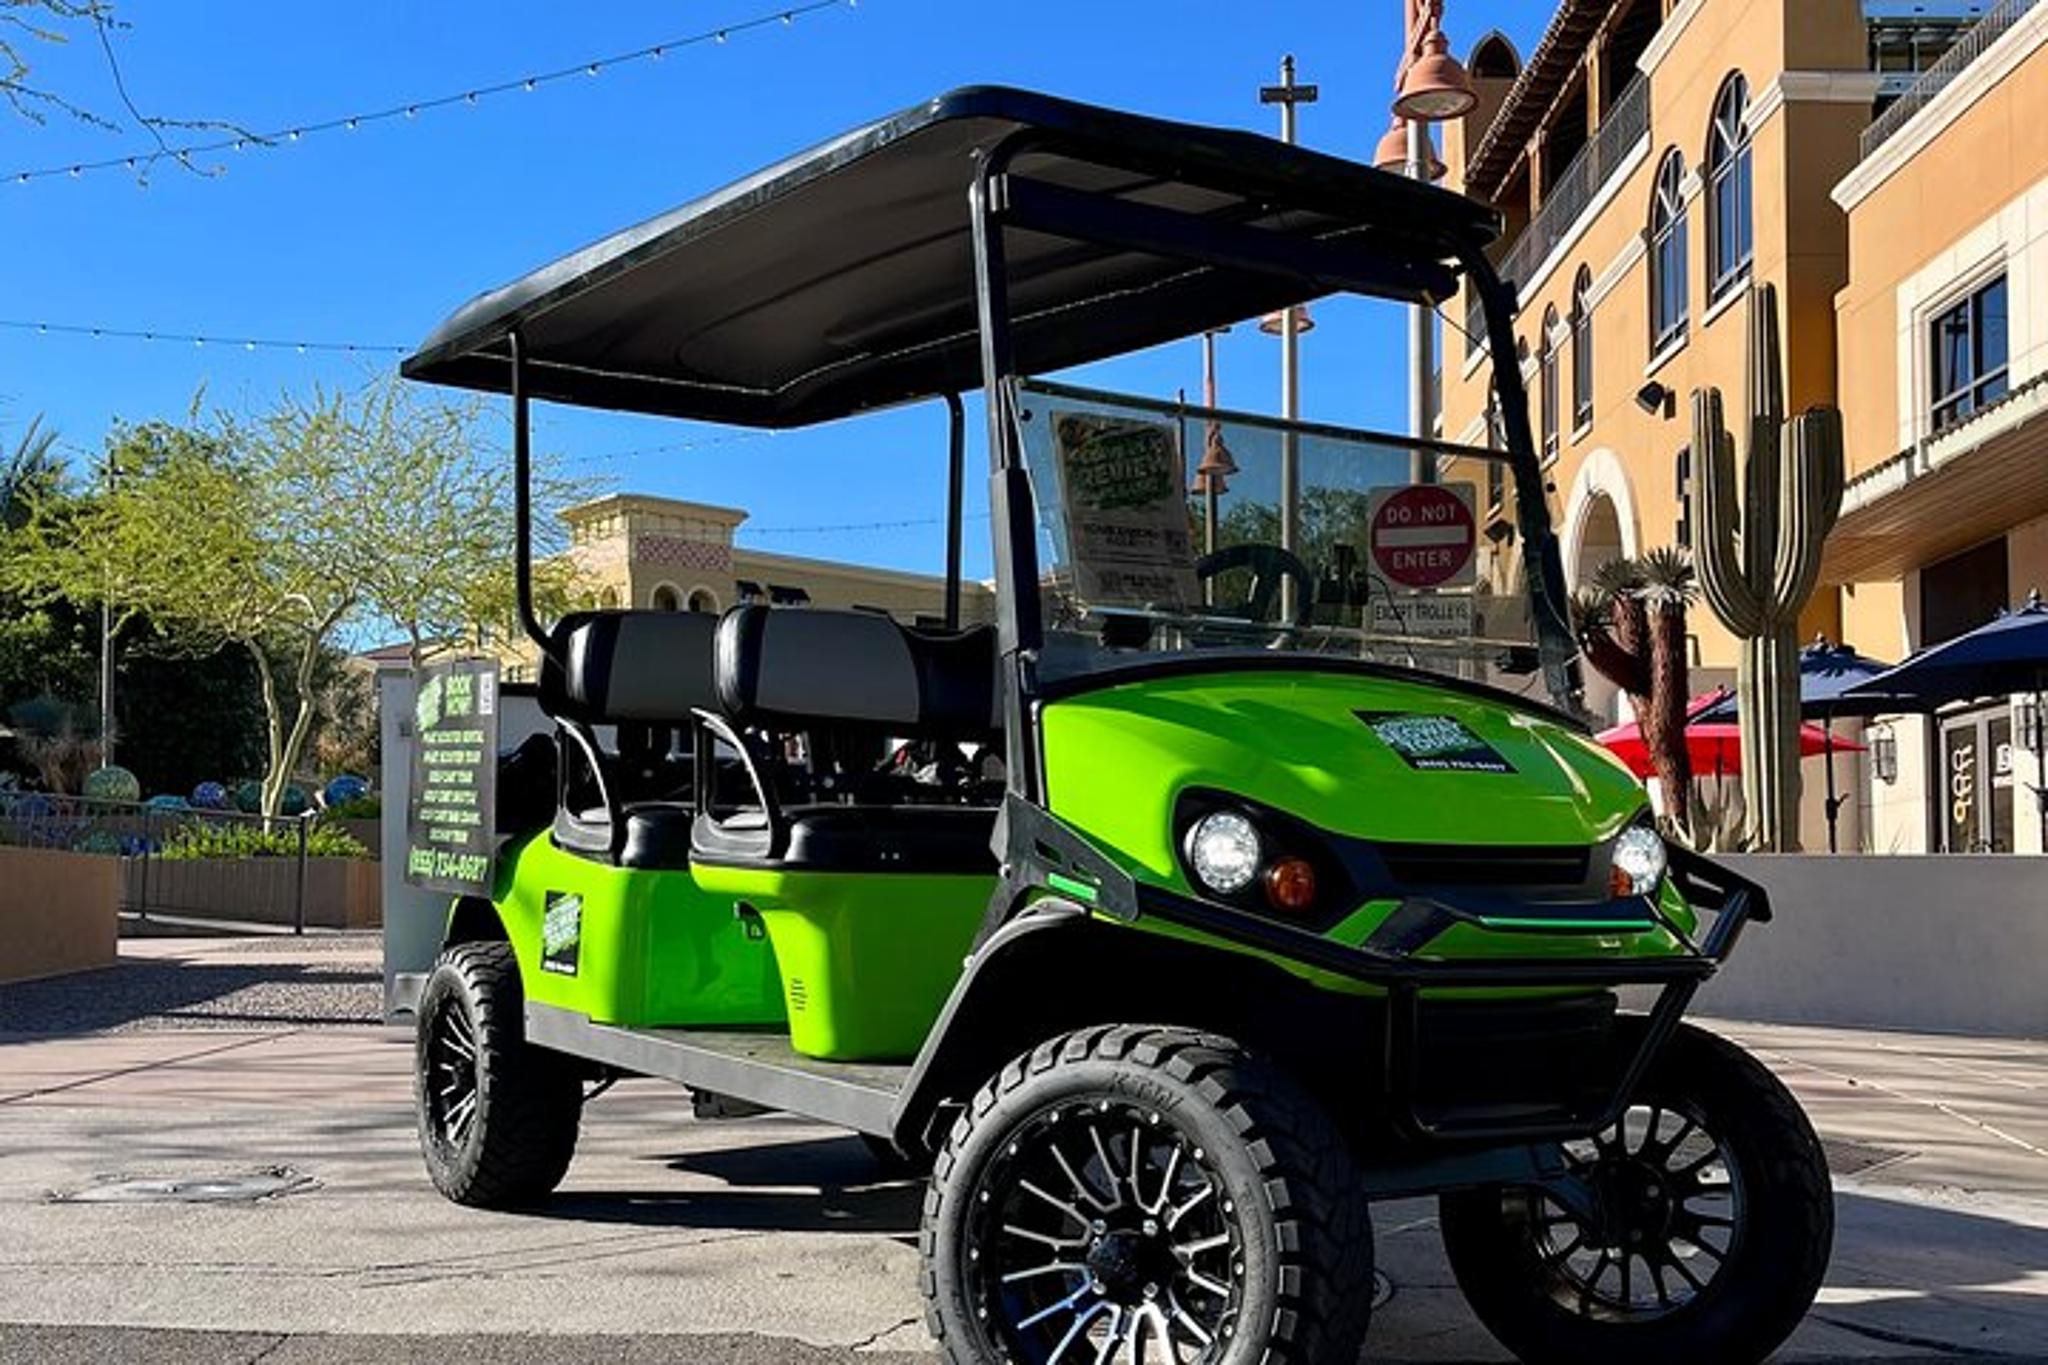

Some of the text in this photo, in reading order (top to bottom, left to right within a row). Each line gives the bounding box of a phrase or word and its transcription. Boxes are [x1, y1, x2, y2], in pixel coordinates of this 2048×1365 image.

[1387, 504, 1456, 523] DO NOT
[1393, 551, 1452, 569] ENTER
